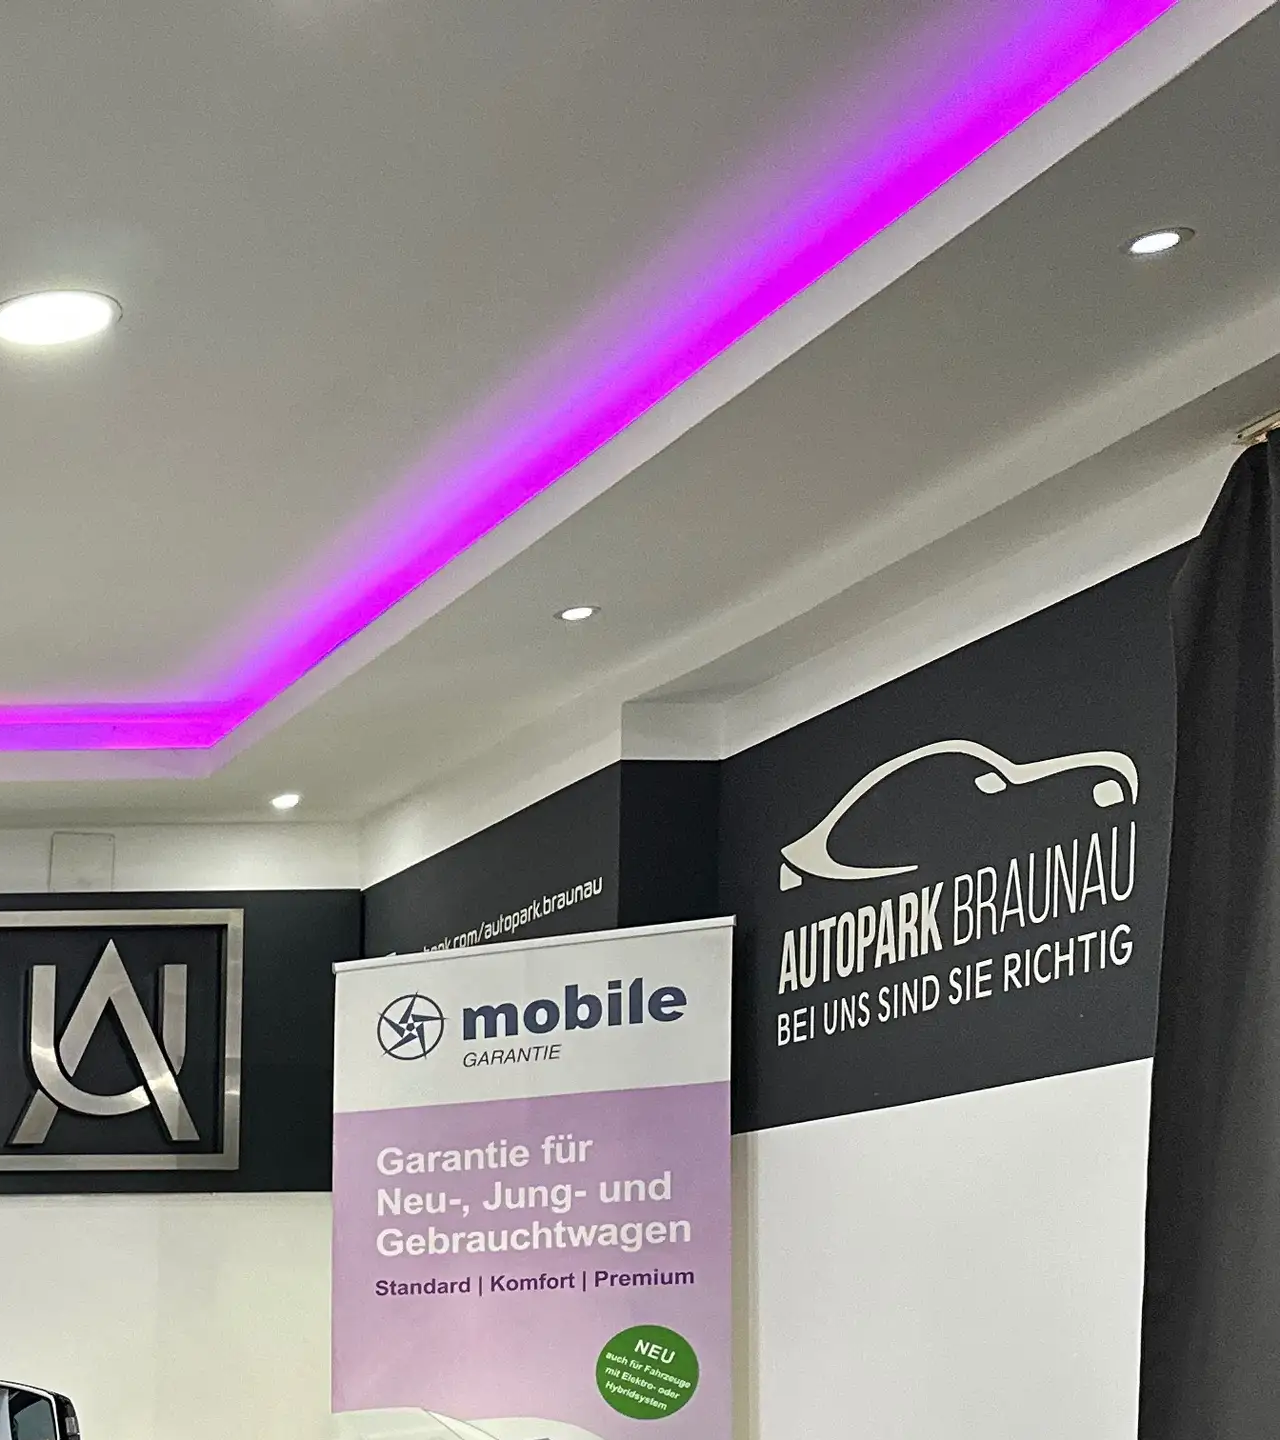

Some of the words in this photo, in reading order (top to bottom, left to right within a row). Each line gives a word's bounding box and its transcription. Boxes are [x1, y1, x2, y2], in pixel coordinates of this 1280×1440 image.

[777, 881, 944, 995] AUTOPARK
[952, 821, 1137, 947] BRAUNAU
[776, 1004, 816, 1048] BEI
[823, 991, 872, 1037] UNS
[877, 973, 940, 1023] SIND
[947, 958, 993, 1006] SIE
[1003, 923, 1134, 992] RICHTIG
[462, 977, 688, 1041] mobile
[462, 1043, 562, 1068] GARANTIE
[376, 1138, 530, 1175] Garantie
[541, 1133, 594, 1165] für
[377, 1187, 470, 1218] Neu-,
[482, 1181, 587, 1213] Jung-
[599, 1171, 672, 1203] und
[376, 1219, 692, 1257] Gebrauchtwagen
[375, 1276, 471, 1296] Standard
[490, 1272, 576, 1293] Komfort
[594, 1268, 695, 1288] Premium
[634, 1339, 676, 1364] NEU
[605, 1352, 628, 1366] auch
[643, 1365, 692, 1389] Fahrzeuge
[605, 1367, 621, 1378] mit
[657, 1386, 681, 1399] oder
[605, 1380, 668, 1411] Hybridsystem
